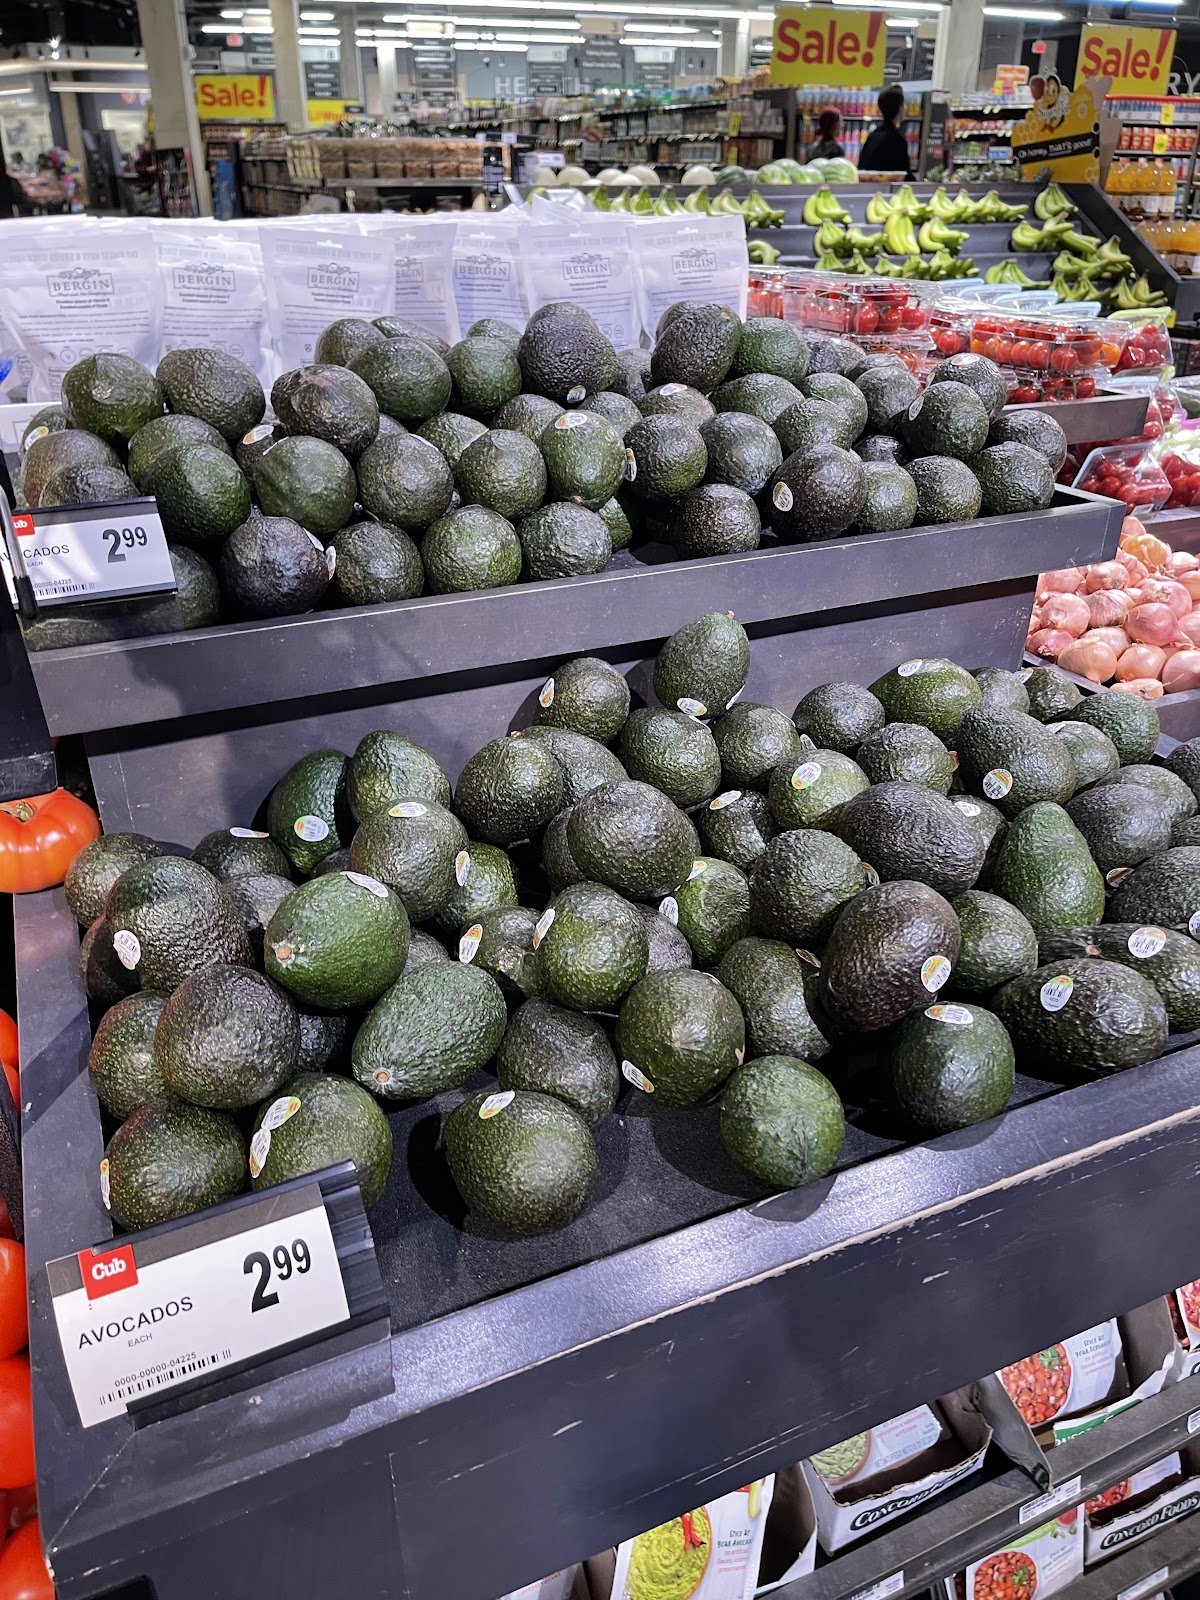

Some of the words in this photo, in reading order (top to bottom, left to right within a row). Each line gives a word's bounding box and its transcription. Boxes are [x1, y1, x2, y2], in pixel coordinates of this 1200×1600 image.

[775, 11, 884, 68] Sale!
[1080, 29, 1172, 81] Sale!
[199, 75, 268, 108] Sale!
[459, 264, 508, 276] BERGIN
[565, 263, 608, 275] BERGIN
[674, 258, 714, 270] BERGIN
[178, 273, 232, 286] BERGIN
[311, 273, 357, 287] BERGIN
[396, 267, 422, 279] ERGIN
[53, 279, 110, 292] BERGIN
[13, 519, 28, 529] ub
[26, 560, 44, 569] EACH
[91, 1257, 126, 1281] Cub
[78, 1295, 194, 1349] AVOCADOS
[127, 1332, 153, 1348] EACH
[114, 1351, 197, 1387] 0000-00000-04225
[1102, 1512, 1160, 1548] CONCORD
[1159, 1494, 1200, 1522] FOODS
